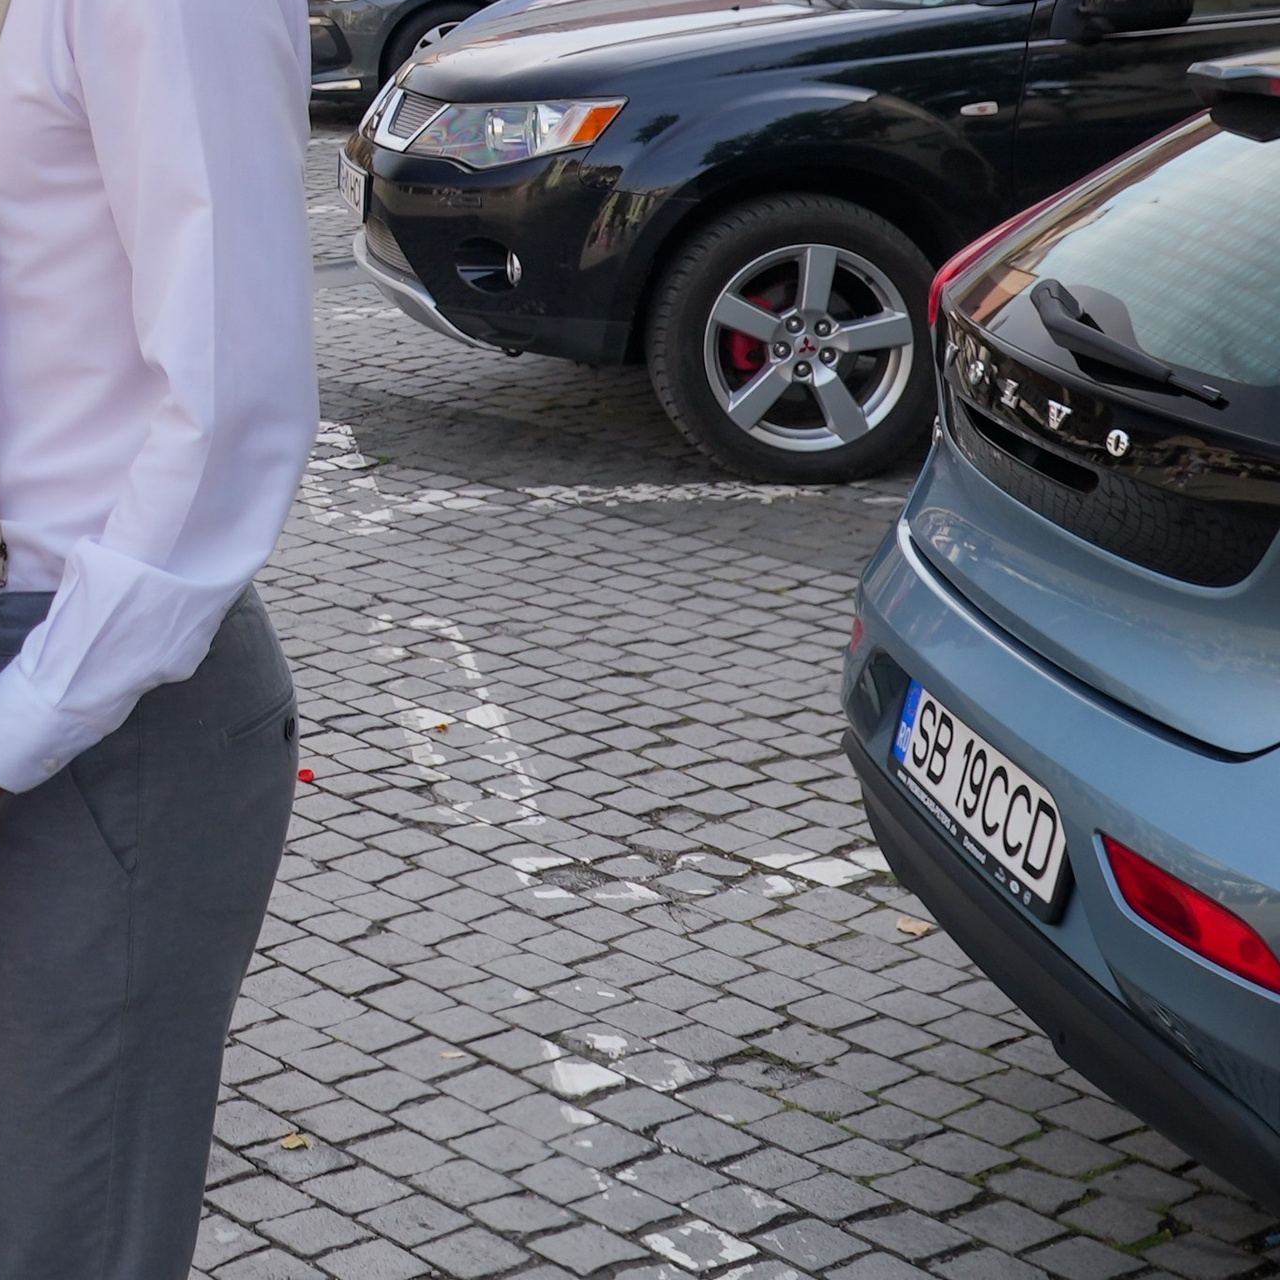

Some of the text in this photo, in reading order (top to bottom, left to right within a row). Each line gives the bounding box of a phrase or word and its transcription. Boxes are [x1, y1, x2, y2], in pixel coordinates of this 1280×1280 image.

[944, 340, 1131, 458] VOLVO
[896, 721, 912, 753] RO
[912, 700, 1058, 880] SB 19CCD
